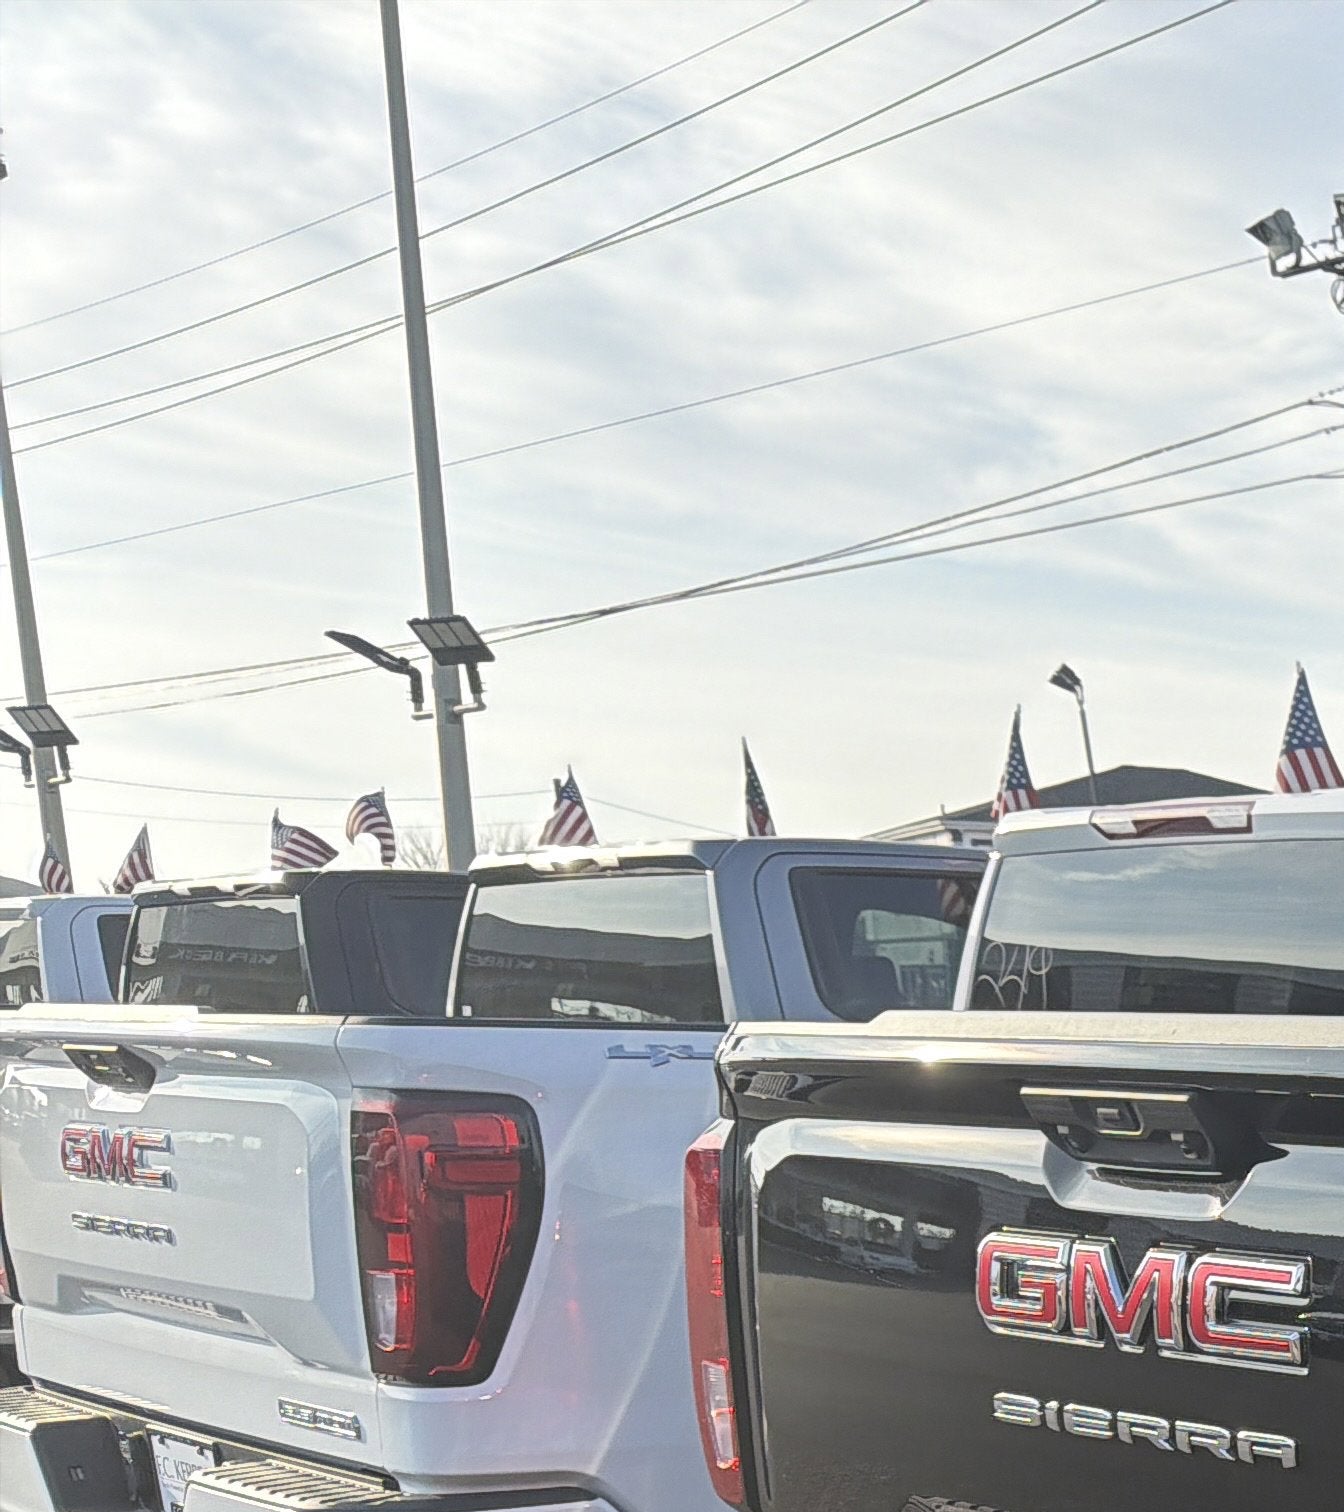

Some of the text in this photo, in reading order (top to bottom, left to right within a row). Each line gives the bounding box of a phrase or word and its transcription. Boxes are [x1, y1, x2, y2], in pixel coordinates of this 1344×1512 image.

[60, 1121, 175, 1192] GMC
[71, 1211, 176, 1246] SIERRA
[976, 1226, 1313, 1376] GMC
[991, 1391, 1298, 1470] SIERRA
